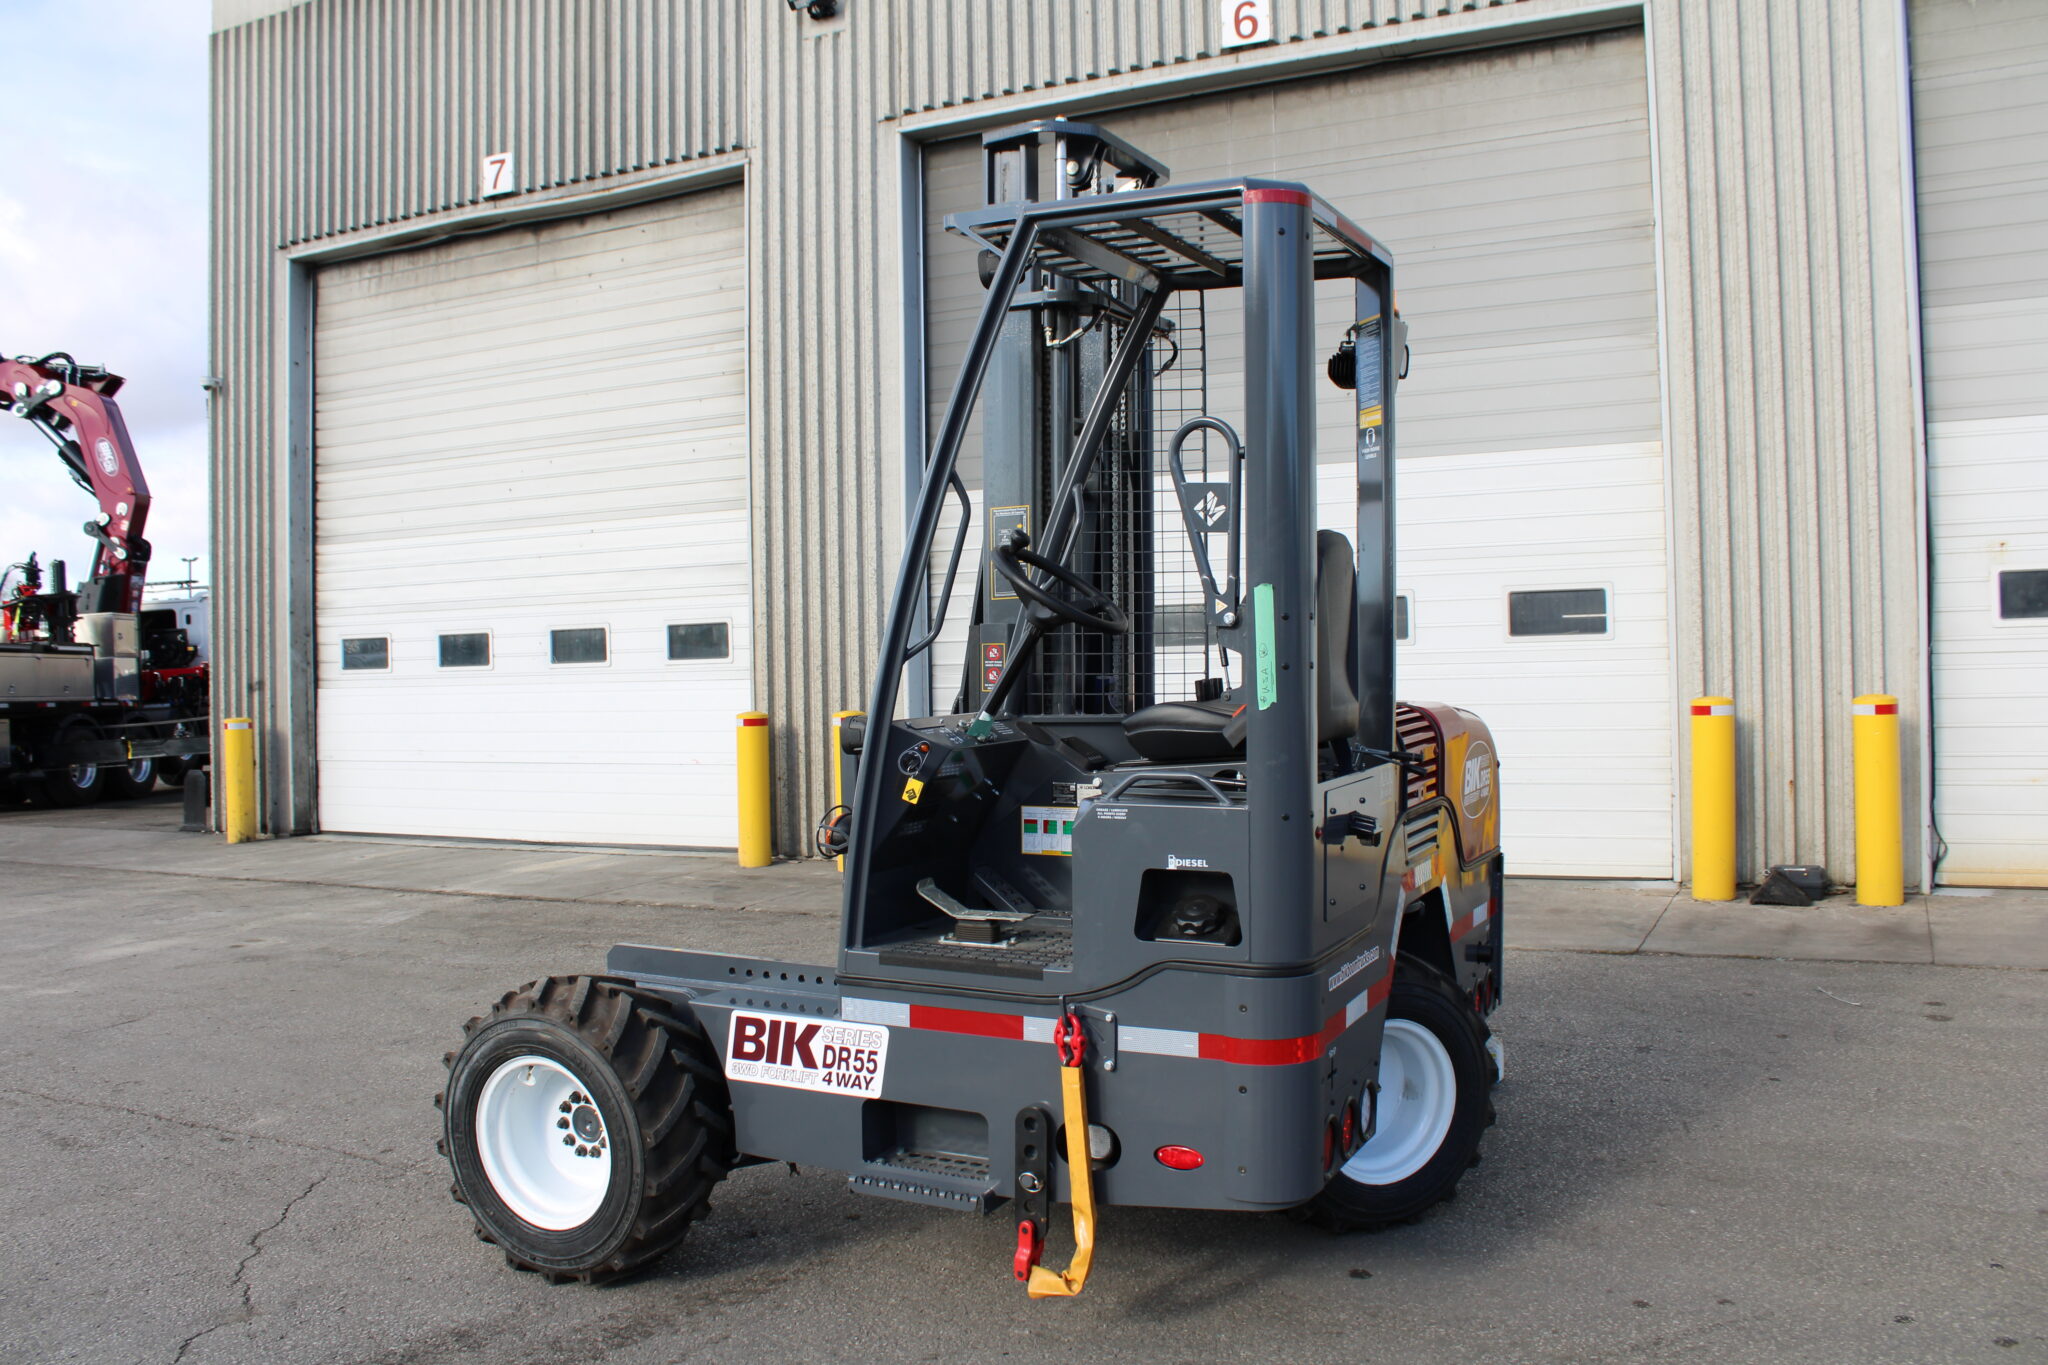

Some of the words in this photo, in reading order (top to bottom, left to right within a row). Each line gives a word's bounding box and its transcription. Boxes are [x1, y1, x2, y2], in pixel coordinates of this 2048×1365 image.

[1234, 1, 1258, 39] 6
[490, 159, 505, 190] 7
[1464, 756, 1482, 796] BIK
[1175, 858, 1209, 868] DIESEL
[732, 1015, 822, 1070] BIK
[822, 1026, 883, 1049] SERIES
[731, 1062, 759, 1077] 3WD
[760, 1065, 819, 1086] FORKLIFT
[822, 1044, 878, 1075] DR55
